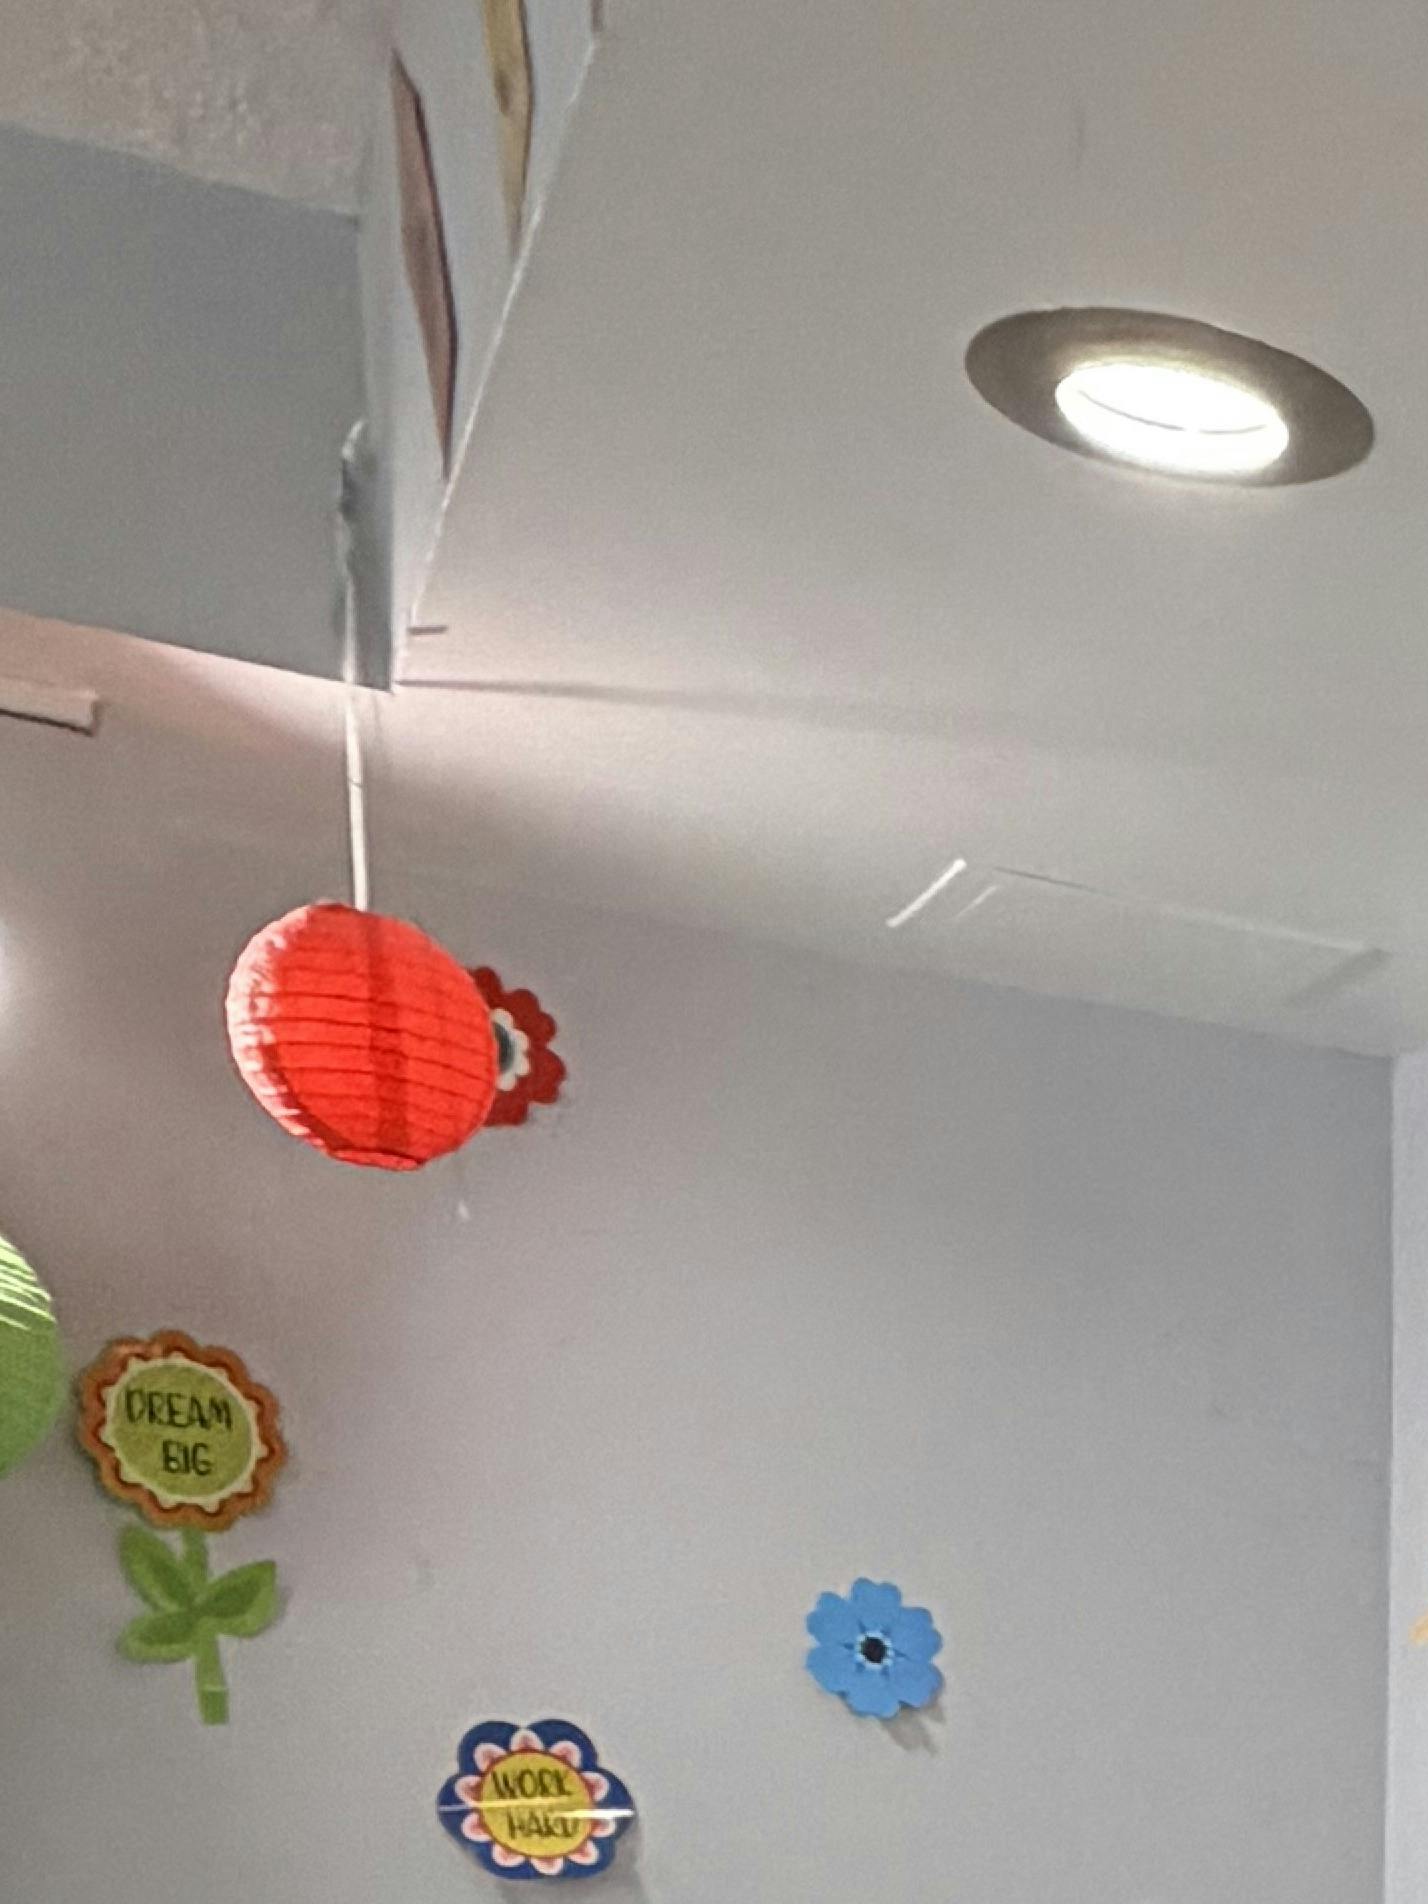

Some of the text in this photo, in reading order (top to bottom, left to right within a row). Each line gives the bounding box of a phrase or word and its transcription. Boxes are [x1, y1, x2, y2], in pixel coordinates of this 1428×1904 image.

[124, 1387, 233, 1433] DREAM
[162, 1439, 212, 1477] BIG
[492, 1768, 573, 1800] WORK
